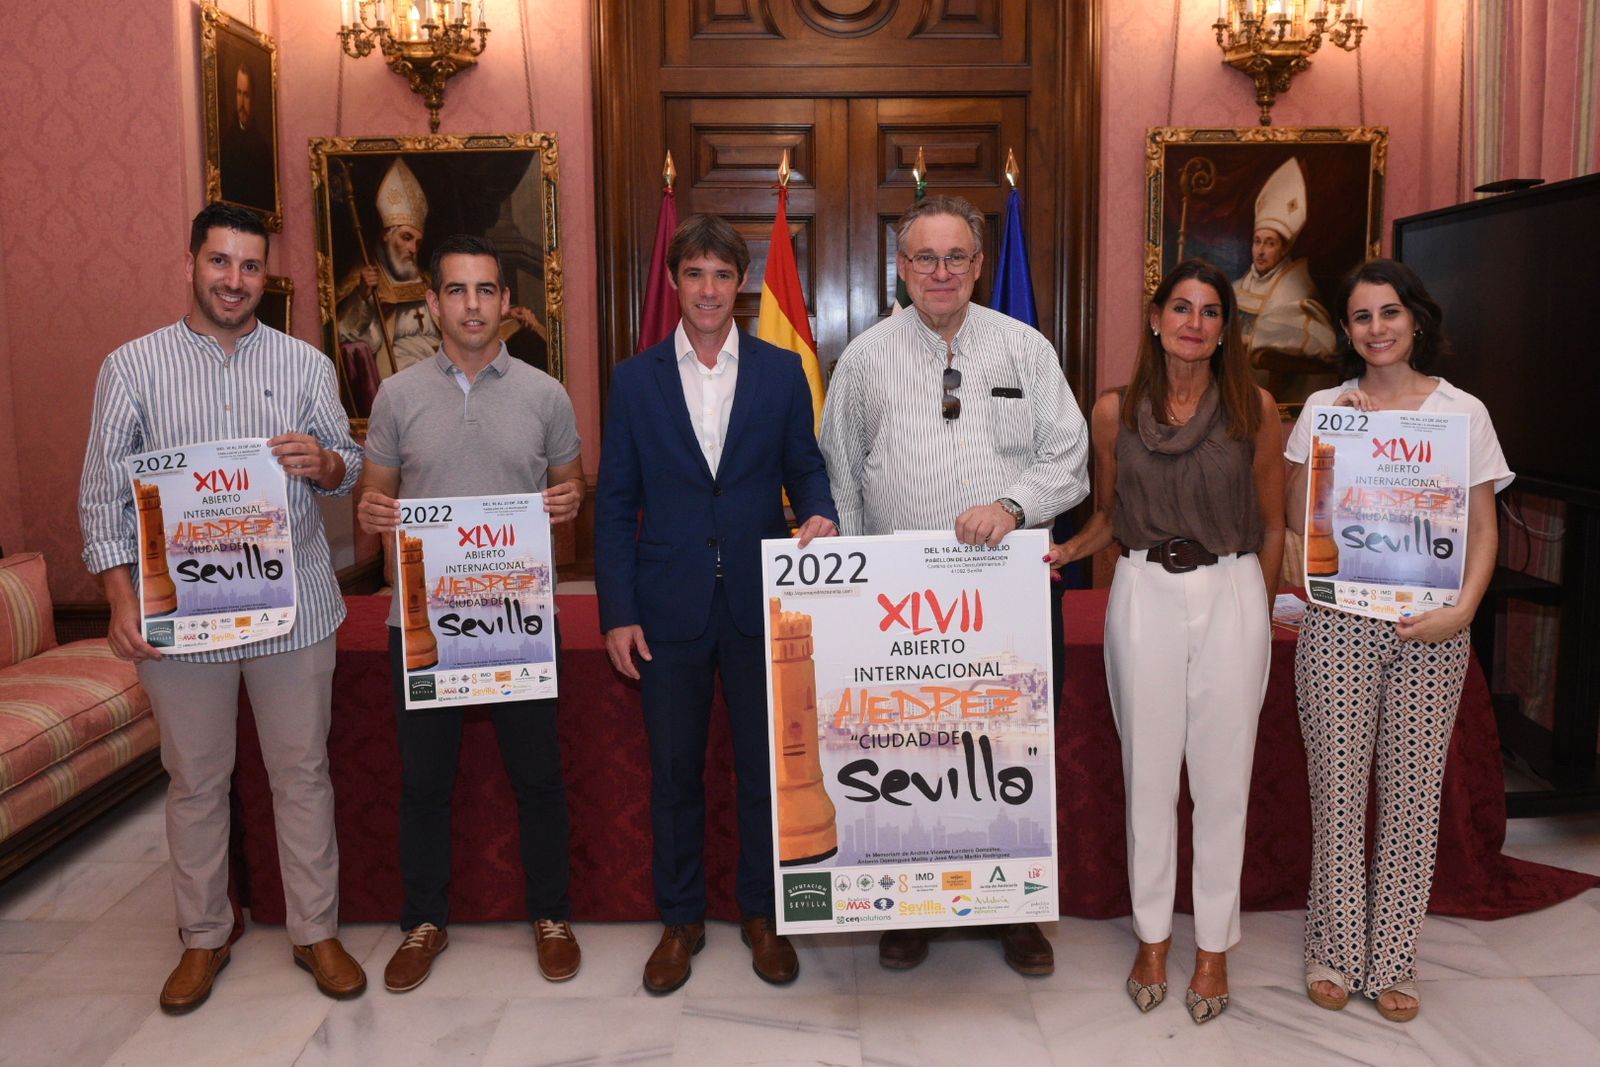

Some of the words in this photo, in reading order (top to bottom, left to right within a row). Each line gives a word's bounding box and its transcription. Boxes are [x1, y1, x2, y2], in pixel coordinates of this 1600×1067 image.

[1318, 413, 1368, 432] 2022
[1372, 437, 1432, 462] XLVII
[133, 452, 187, 474] 2022
[1377, 464, 1420, 474] ABIERTO
[193, 468, 249, 493] XLVII
[1356, 476, 1441, 488] INTERNACIONAL
[202, 494, 240, 504] ABIERTO
[184, 505, 262, 519] INTERNACIONAL
[402, 505, 453, 524] 2022
[1400, 514, 1413, 524] DE
[458, 524, 515, 548] XLVII
[230, 542, 243, 550] DE
[465, 549, 506, 560] ABIERTO
[446, 561, 526, 573] INTERNACIONAL
[774, 552, 868, 586] 2022
[491, 597, 503, 606] DE
[877, 588, 983, 635] XLVII
[890, 639, 965, 656] ABIERTO
[854, 662, 1003, 682] INTERNACIONAL
[938, 731, 959, 745] DE
[915, 872, 934, 881] IMD
[790, 900, 827, 908] SEVILLA
[846, 900, 871, 910] MAS
